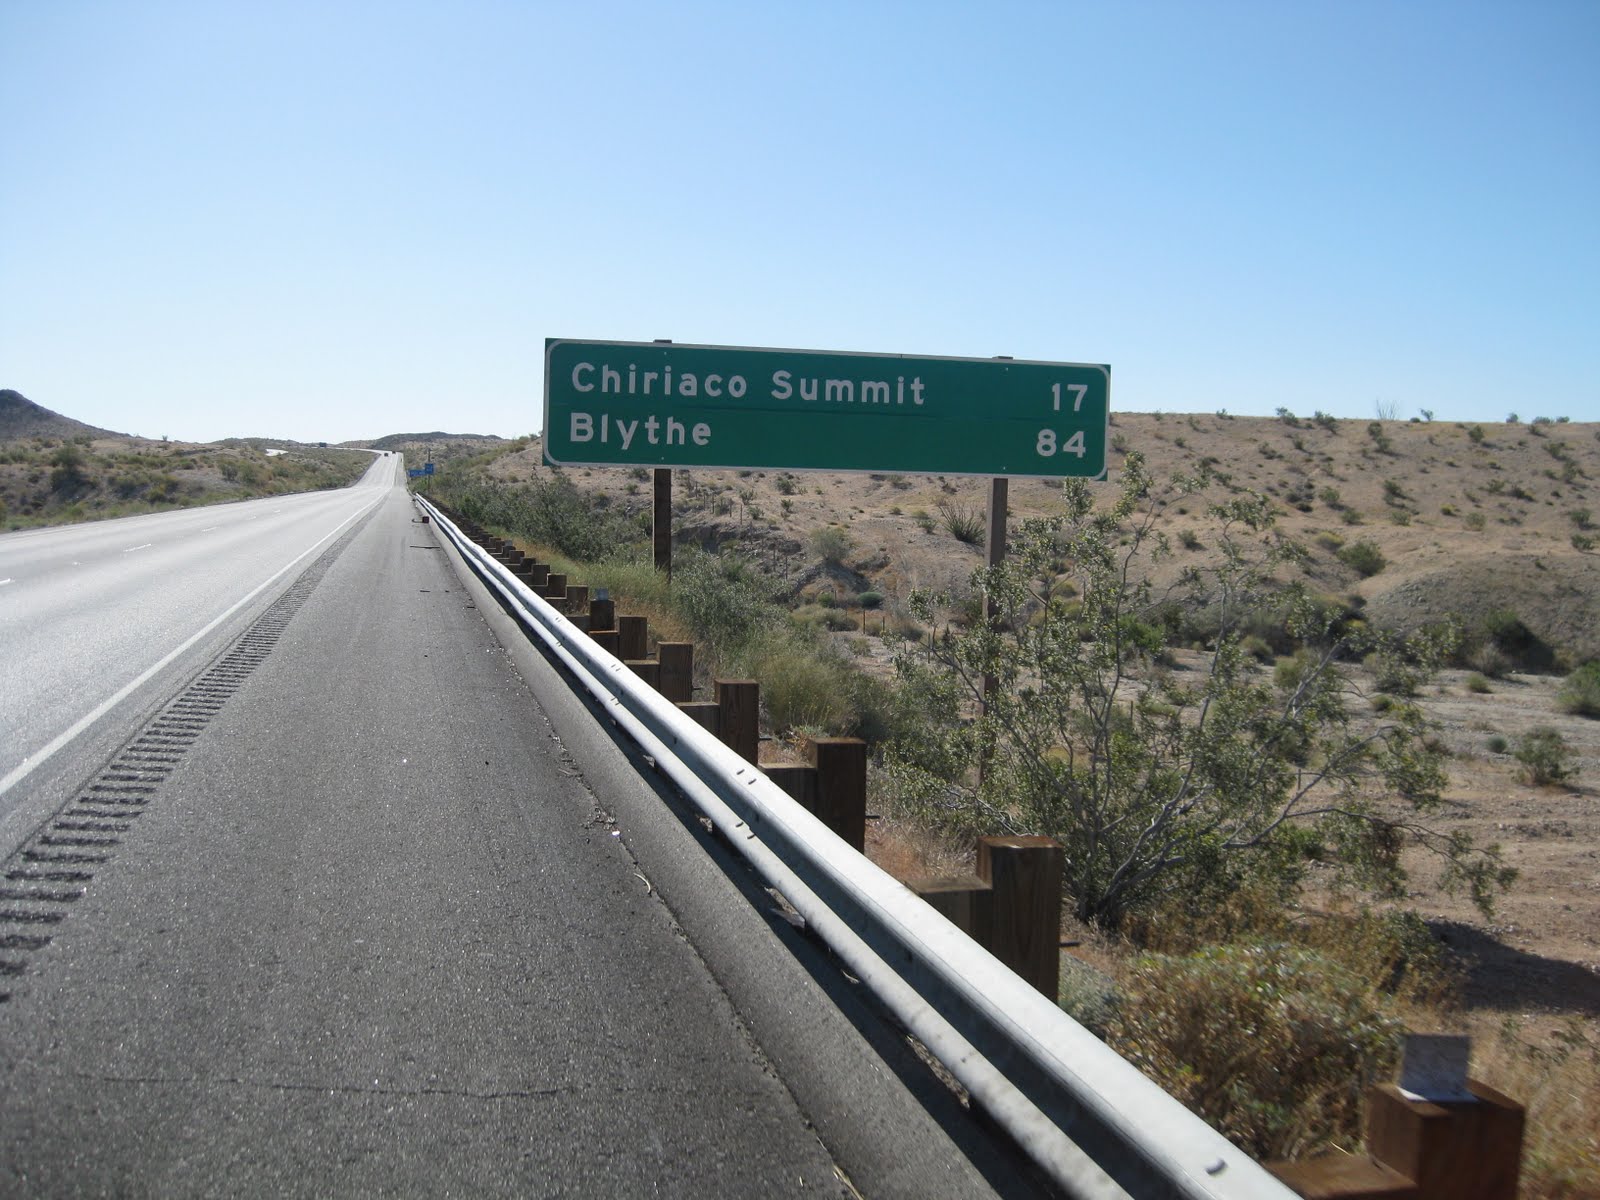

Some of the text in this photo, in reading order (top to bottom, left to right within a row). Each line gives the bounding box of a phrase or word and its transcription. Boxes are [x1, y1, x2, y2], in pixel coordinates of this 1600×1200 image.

[572, 362, 925, 405] Chiriaco Summit
[1051, 383, 1088, 412] 17
[570, 412, 711, 450] Blythe
[1036, 428, 1086, 458] 84
